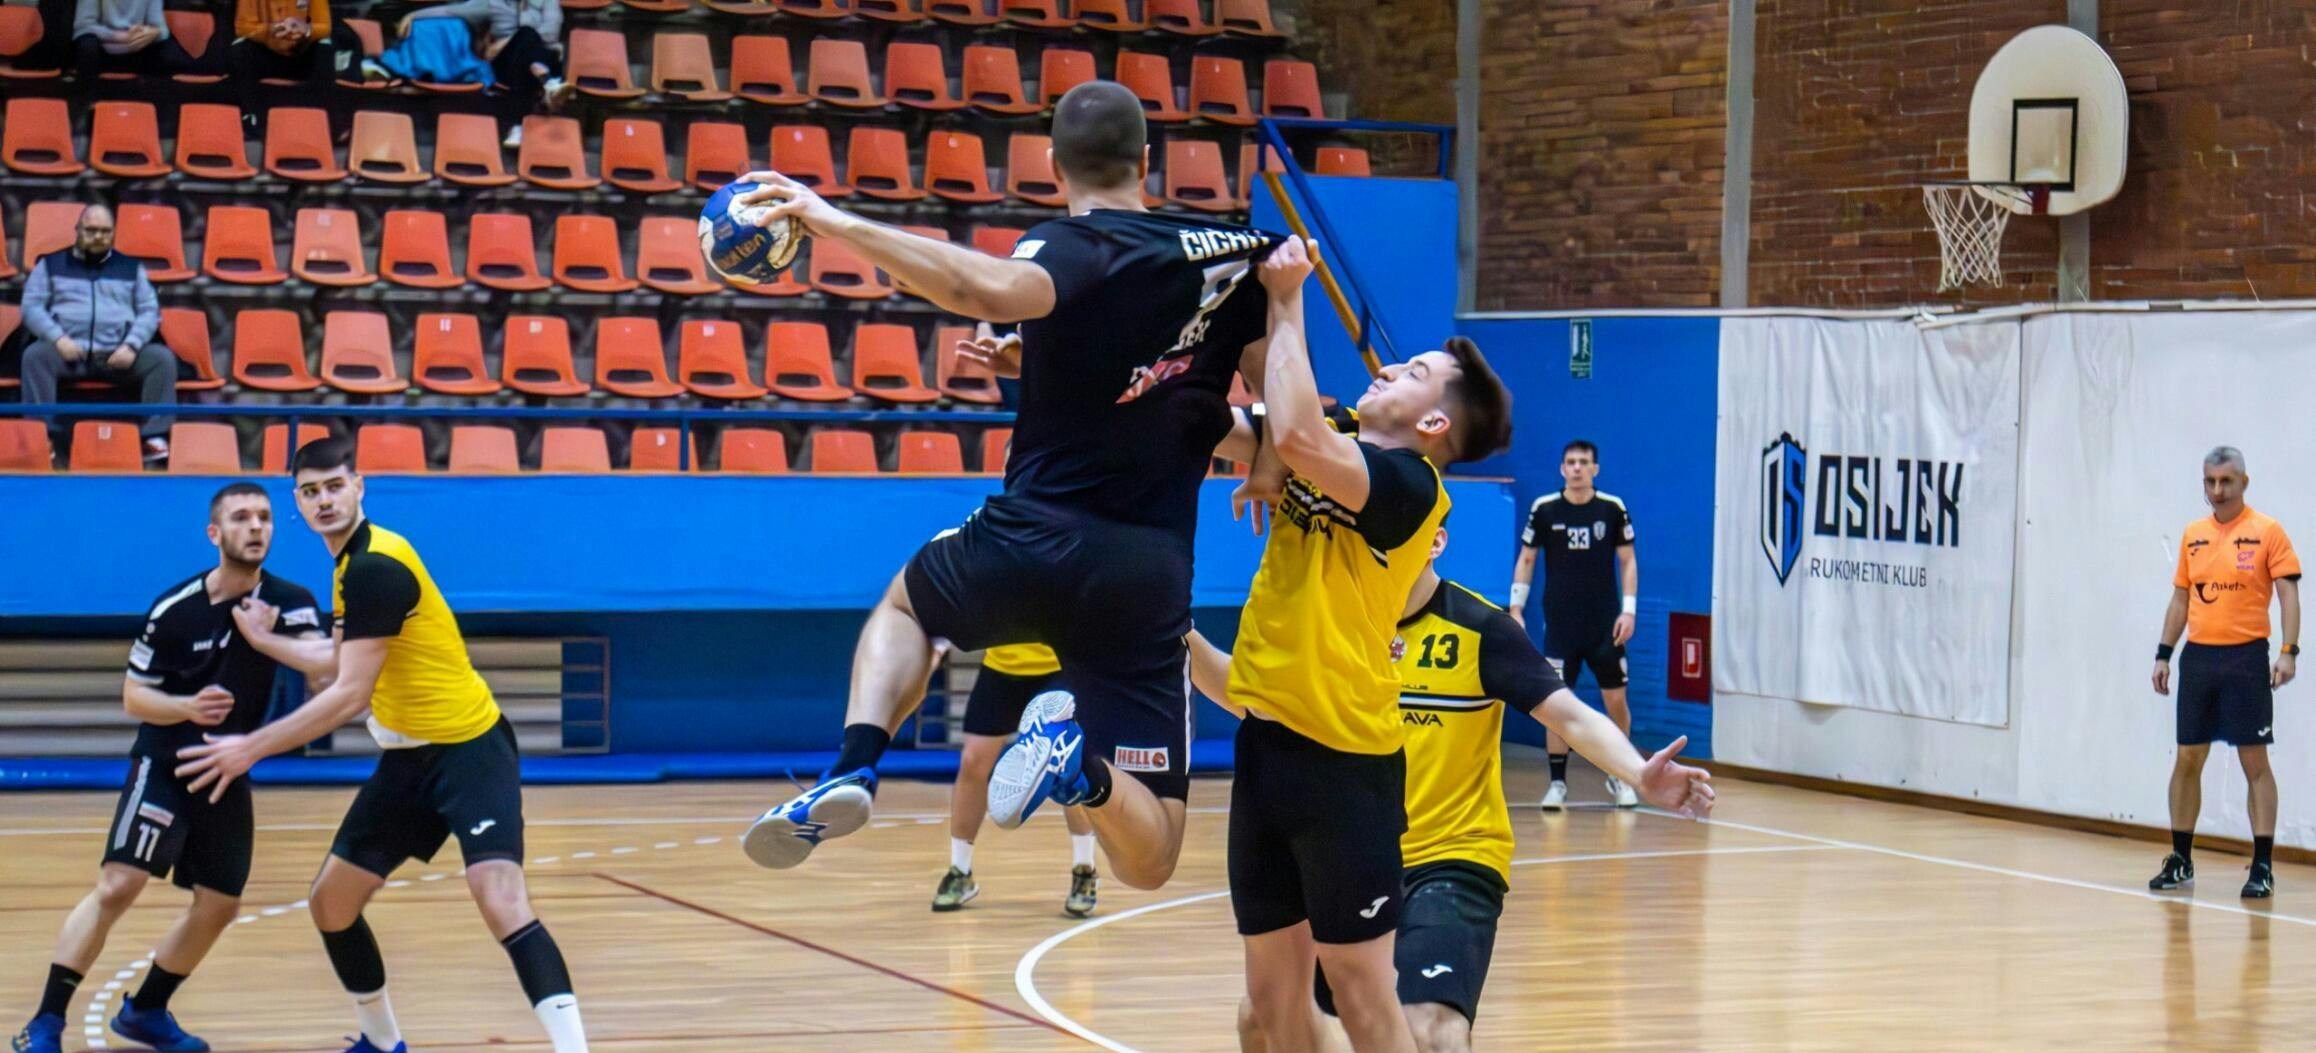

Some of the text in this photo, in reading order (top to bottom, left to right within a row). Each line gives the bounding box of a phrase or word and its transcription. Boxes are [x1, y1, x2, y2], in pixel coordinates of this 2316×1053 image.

[1813, 454, 1964, 547] OSIJEK
[1567, 527, 1590, 549] 33
[1809, 557, 1928, 588] RUKOMETNI KLUB
[1417, 633, 1460, 669] 13
[1402, 711, 1444, 727] AVA
[1116, 748, 1151, 766] HELL
[134, 821, 162, 862] 11
